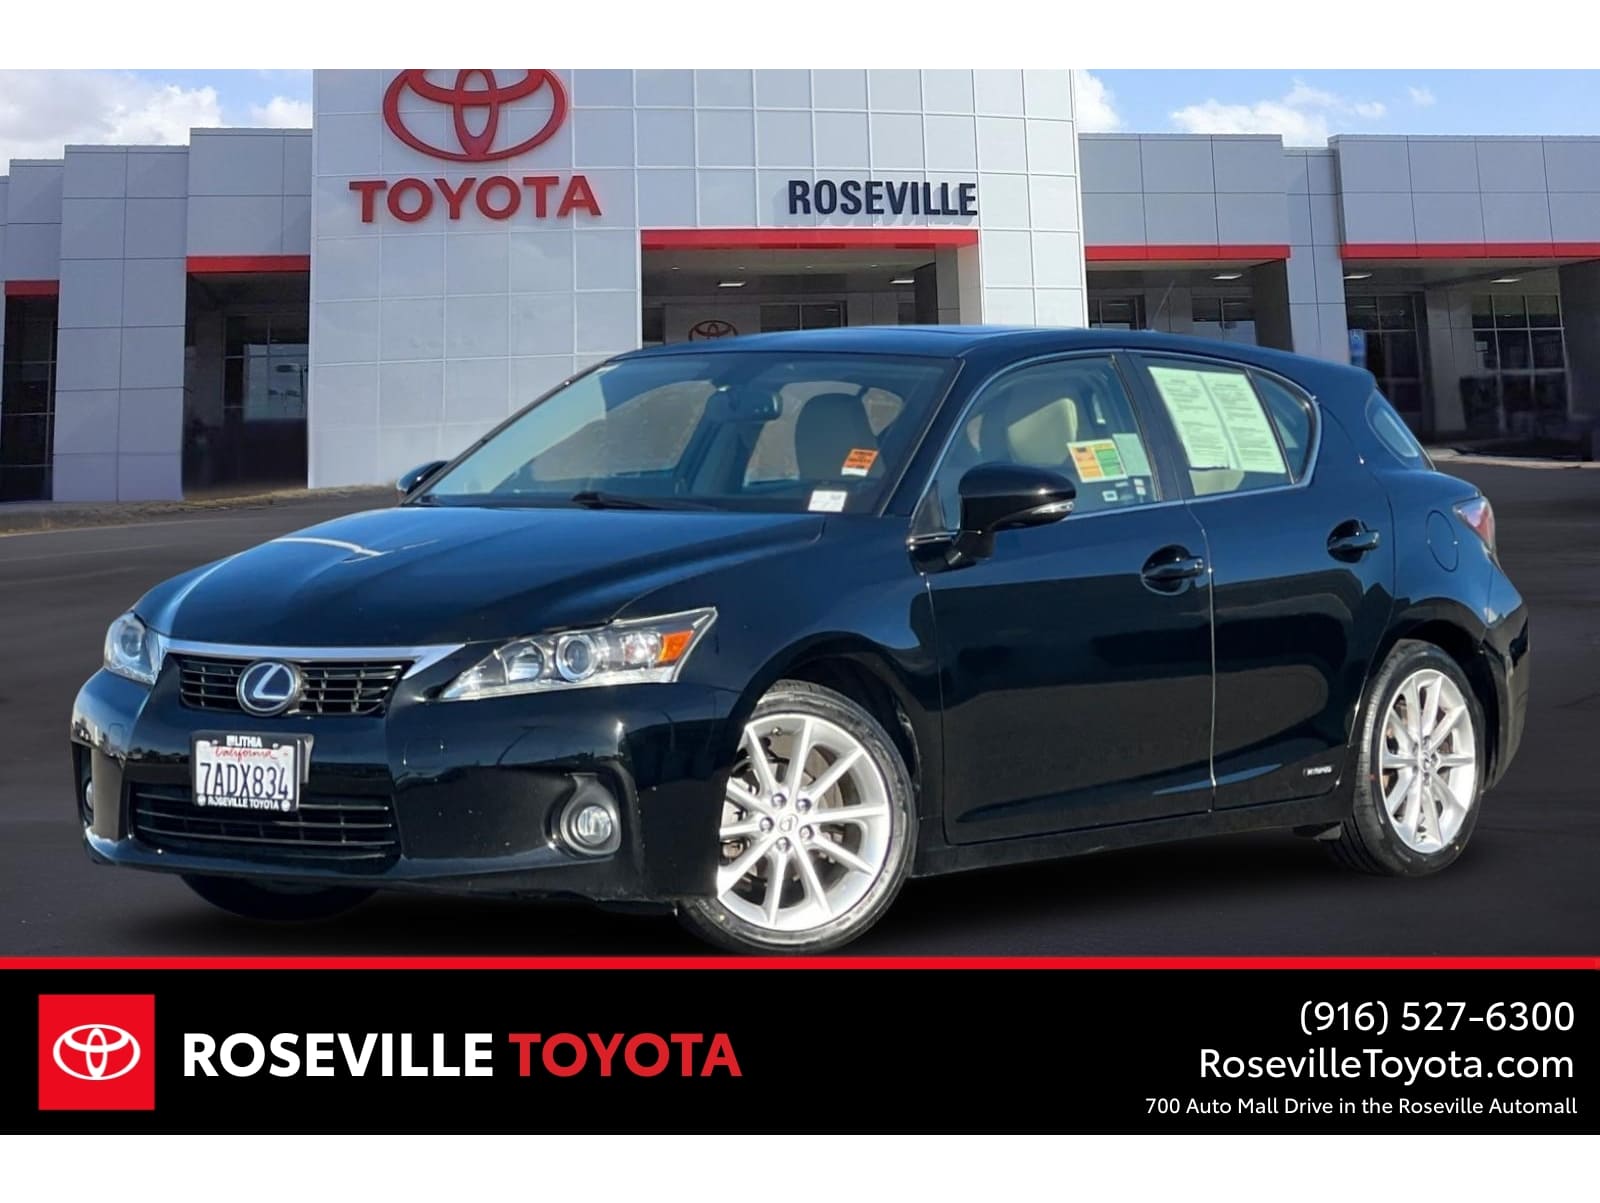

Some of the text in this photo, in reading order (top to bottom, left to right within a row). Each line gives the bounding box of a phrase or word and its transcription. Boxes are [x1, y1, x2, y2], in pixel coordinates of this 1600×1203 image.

[349, 175, 601, 223] TOYOTA
[788, 179, 978, 216] ROSEVILLE
[199, 762, 289, 800] 7ADX834
